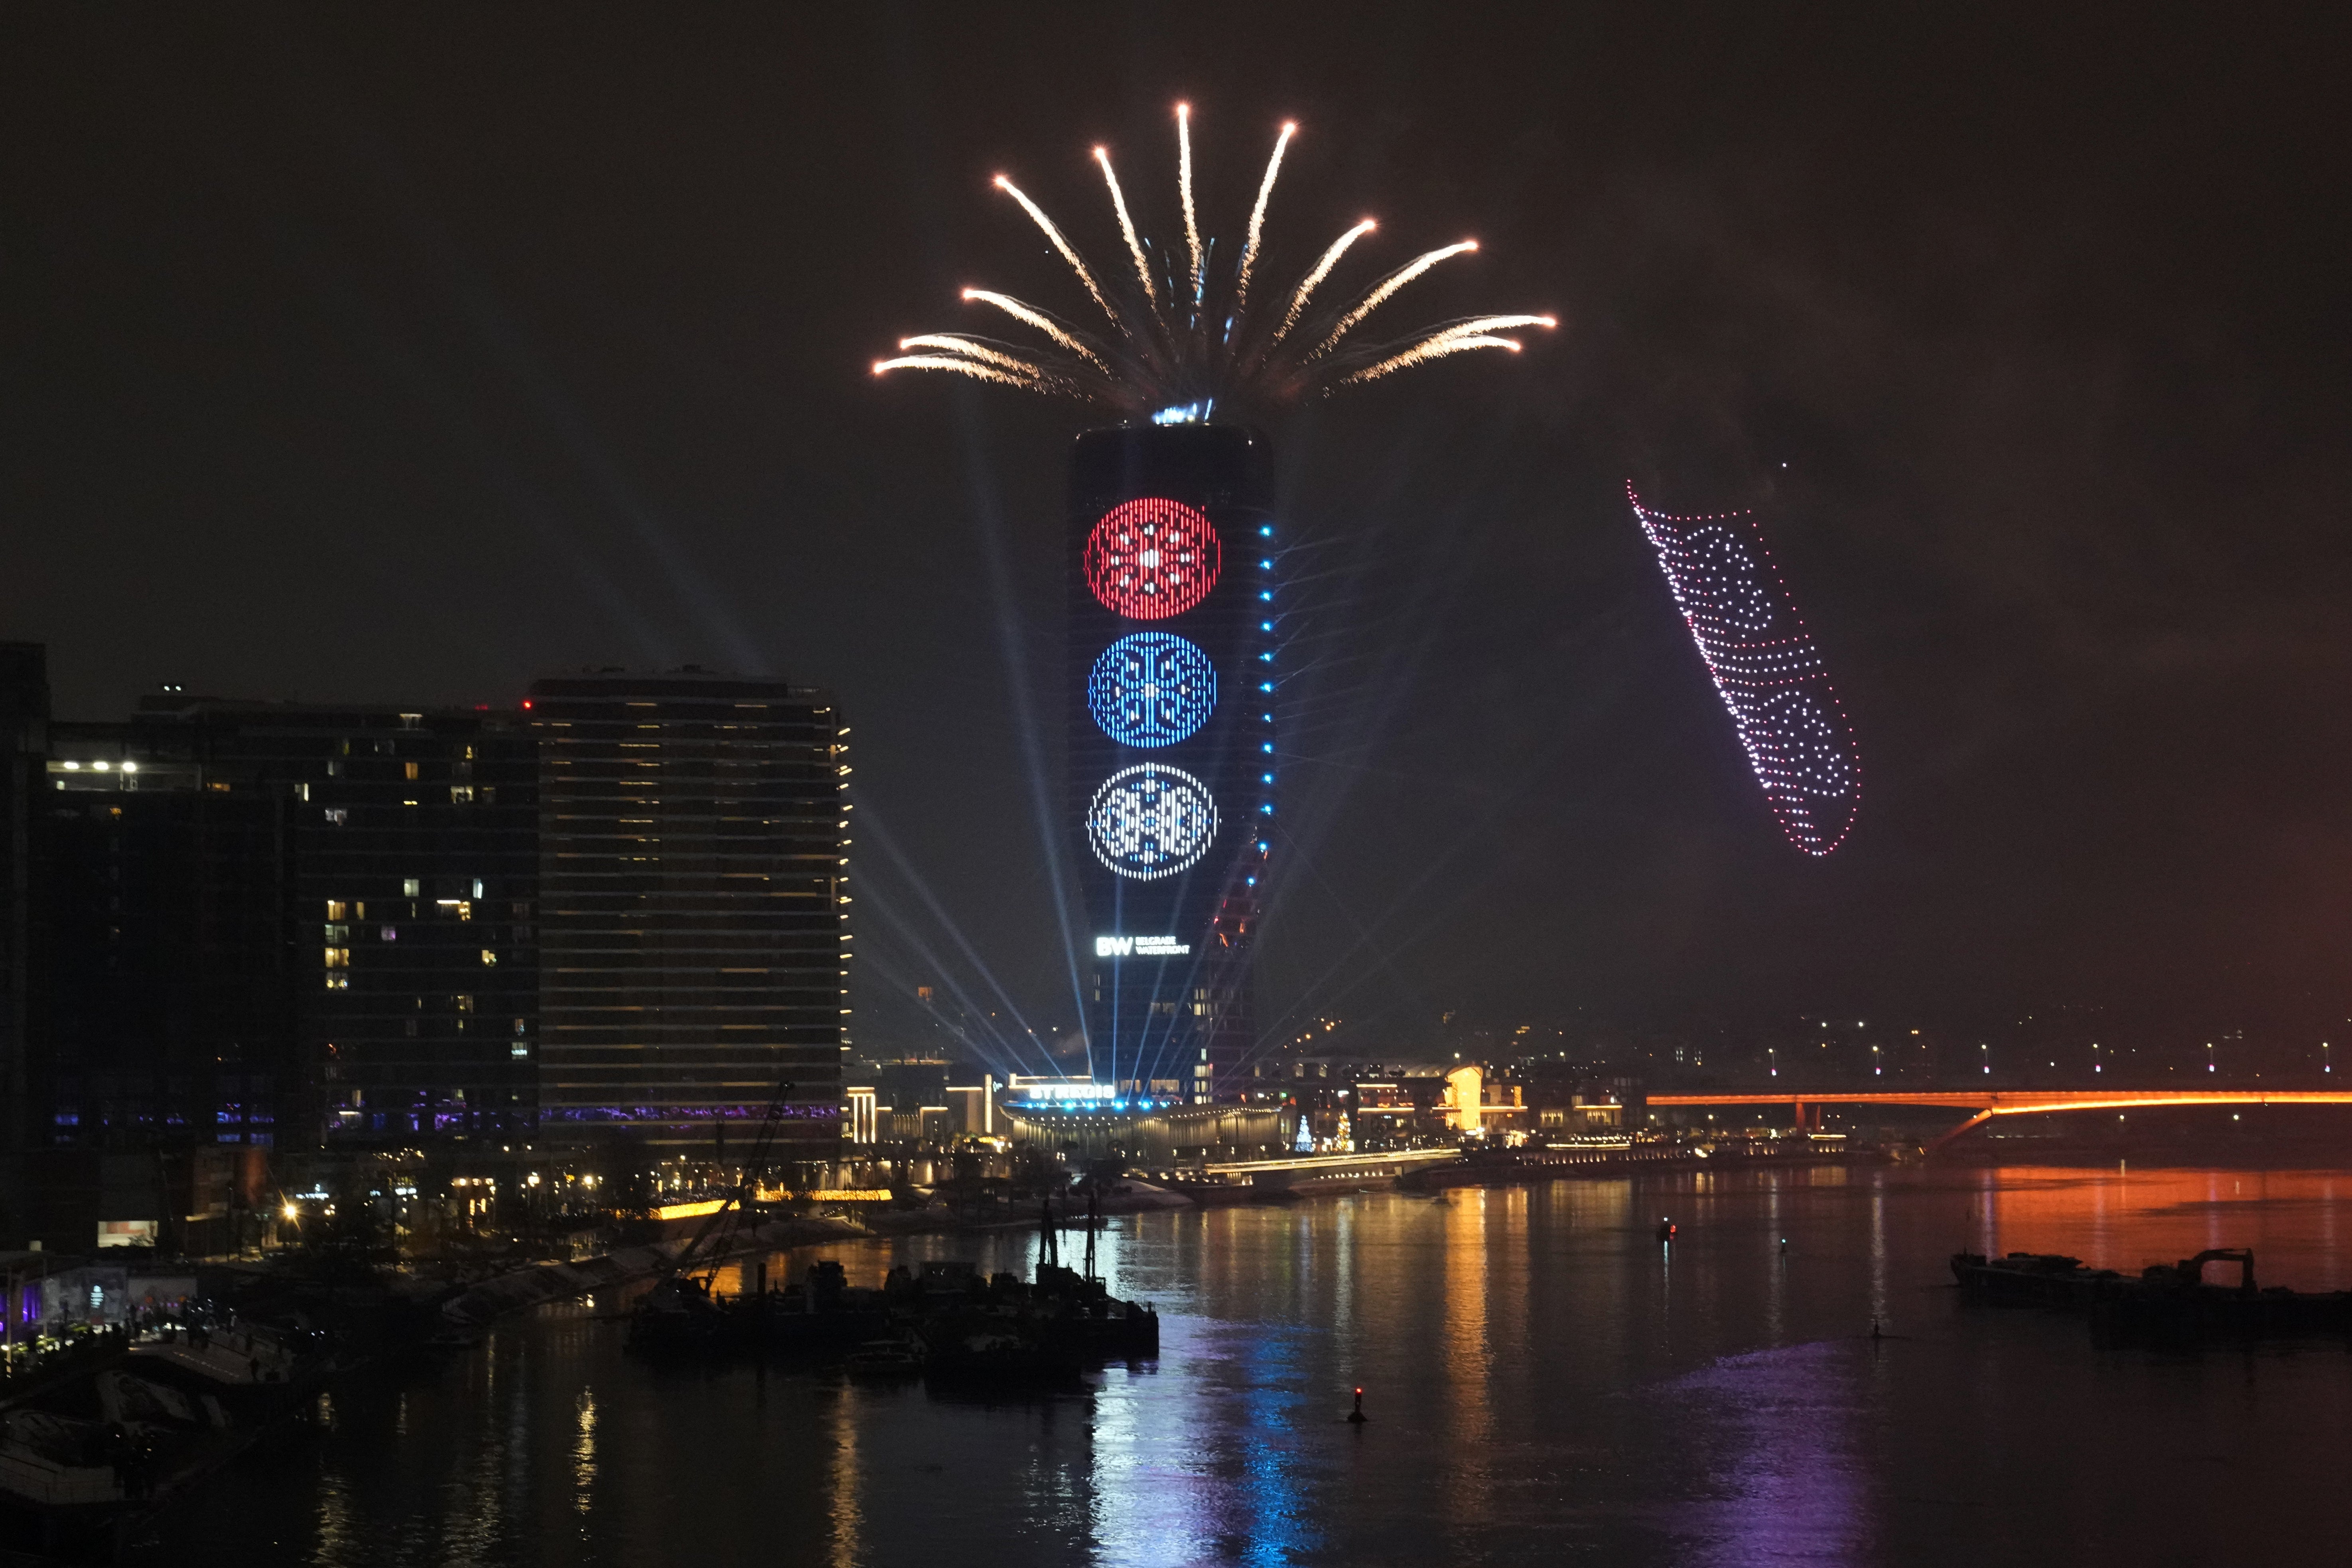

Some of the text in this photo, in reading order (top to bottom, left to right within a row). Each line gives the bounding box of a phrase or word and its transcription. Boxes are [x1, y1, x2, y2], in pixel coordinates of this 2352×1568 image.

[1135, 936, 1176, 945] BELGRADE
[1096, 937, 1134, 956] BW
[1135, 945, 1190, 955] WATERFRONT
